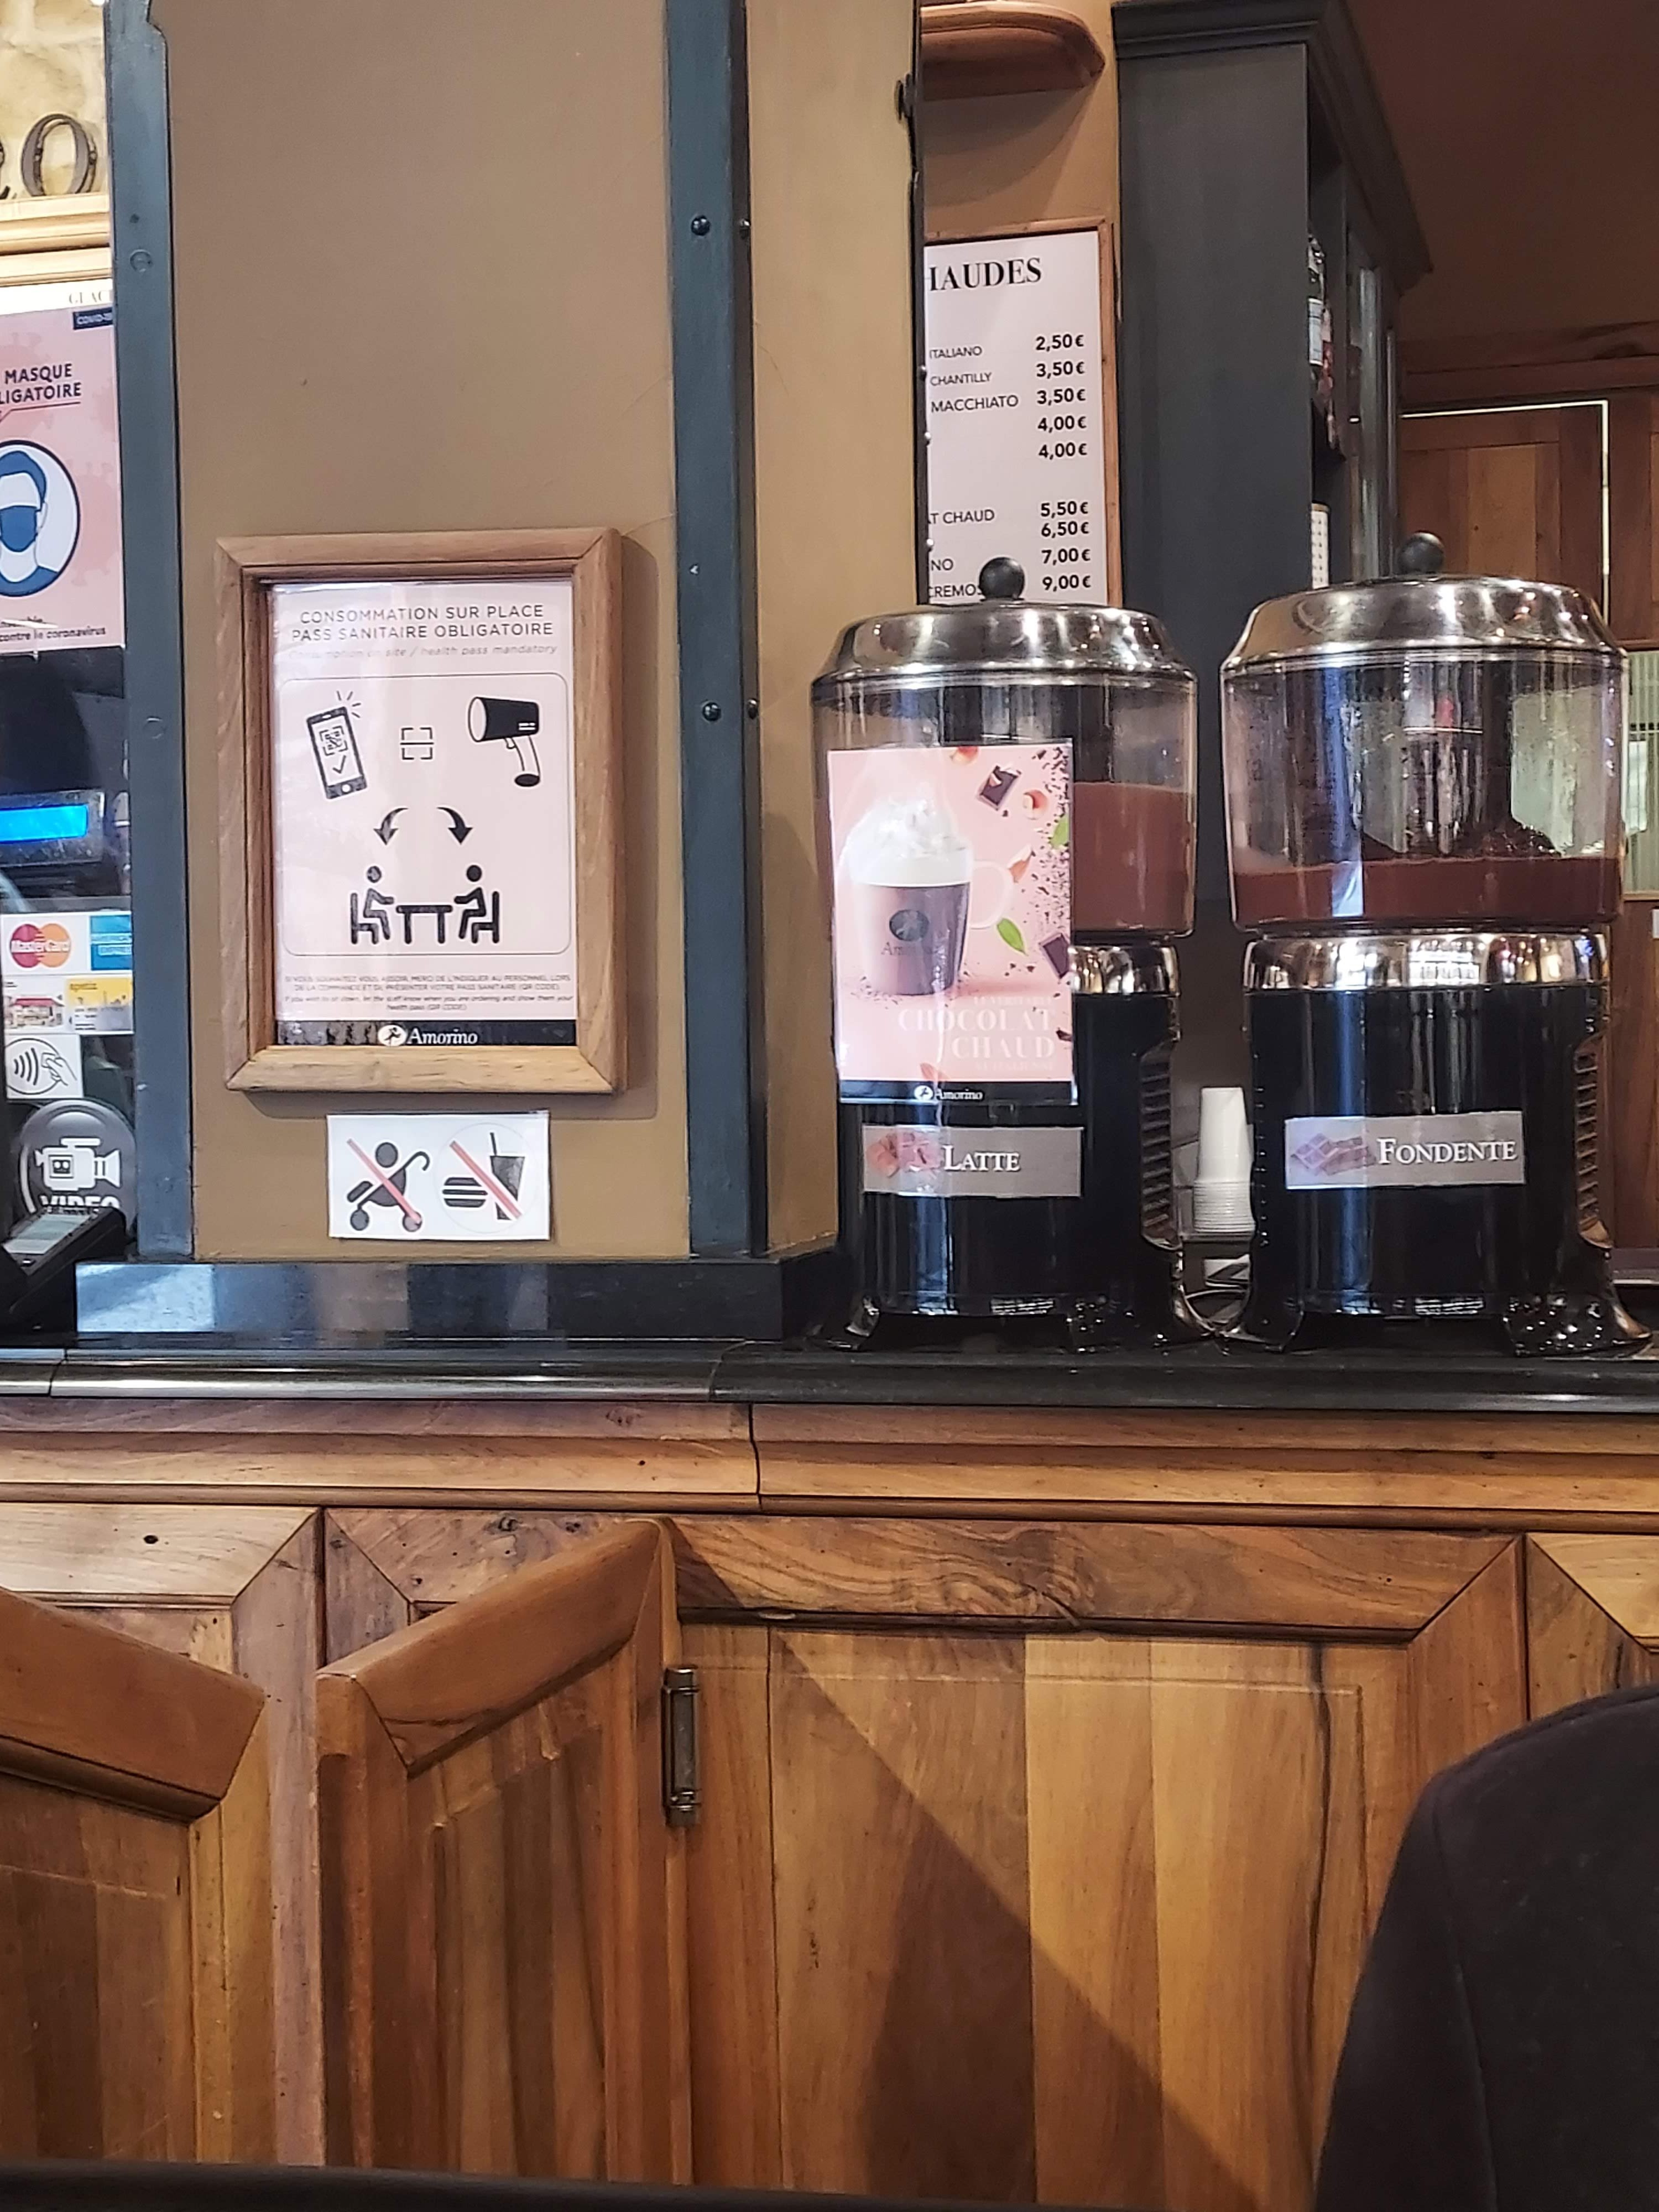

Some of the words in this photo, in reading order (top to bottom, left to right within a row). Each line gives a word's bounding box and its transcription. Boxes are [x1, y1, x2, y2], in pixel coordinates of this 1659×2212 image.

[930, 346, 982, 359] ITALIANO
[5, 363, 72, 384] MASQUE
[930, 372, 992, 386] CHANTILLY
[931, 394, 1018, 413] MACCHIATO
[943, 509, 995, 524] CHAUD
[300, 608, 438, 624] CONSOMMATION
[446, 607, 479, 619] SUR
[487, 605, 542, 618] PLACE
[292, 629, 331, 641] PASS
[338, 625, 427, 640] SANITAIRE
[435, 623, 552, 637] OBLIGATOIRE
[492, 644, 557, 654] mandatory
[898, 1008, 1051, 1032] CHOCOLAT
[407, 1027, 478, 1045] Amorino
[951, 1036, 1056, 1059] CHAUD
[935, 1088, 983, 1100] Amorino
